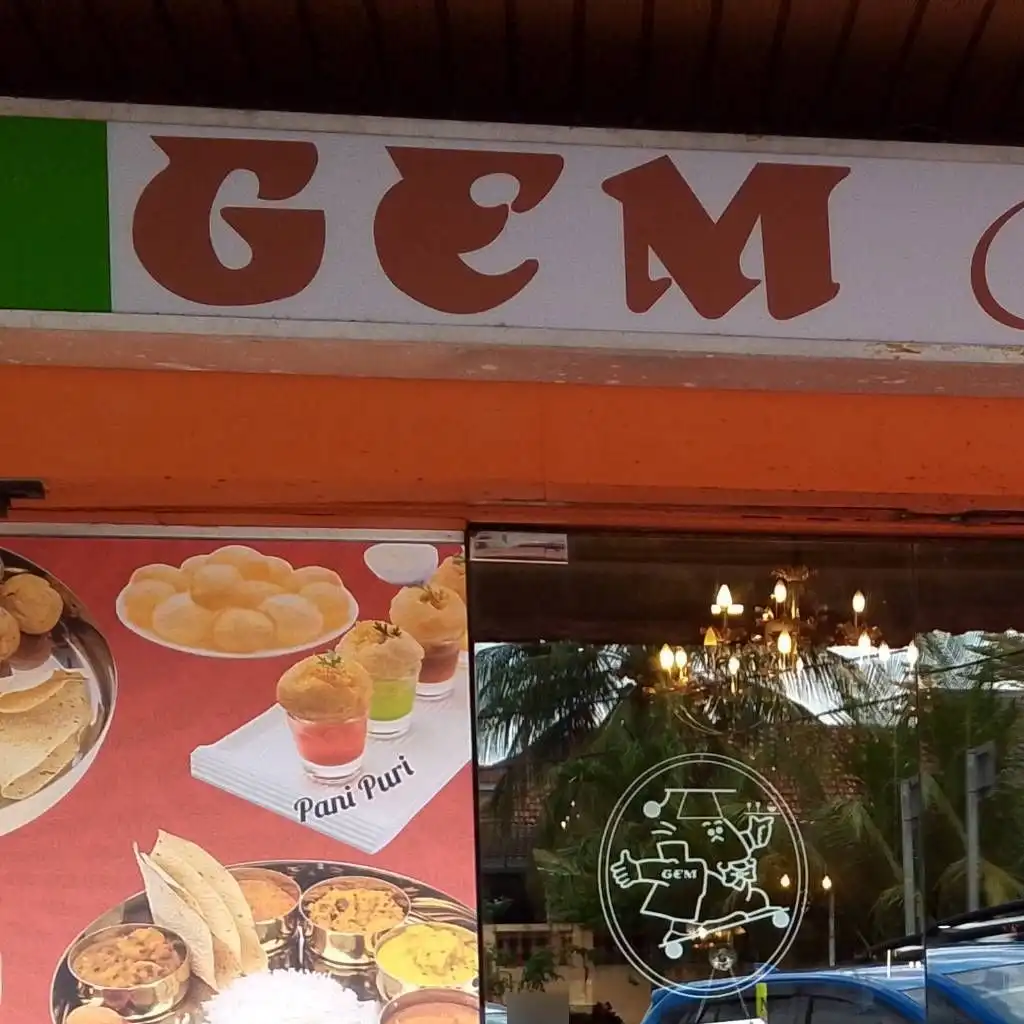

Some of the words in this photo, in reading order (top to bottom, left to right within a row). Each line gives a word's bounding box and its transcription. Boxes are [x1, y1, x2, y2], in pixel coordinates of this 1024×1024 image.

[132, 135, 851, 320] GEM
[293, 785, 357, 823] Pani
[357, 755, 415, 800] Puri
[661, 868, 698, 879] GEM
